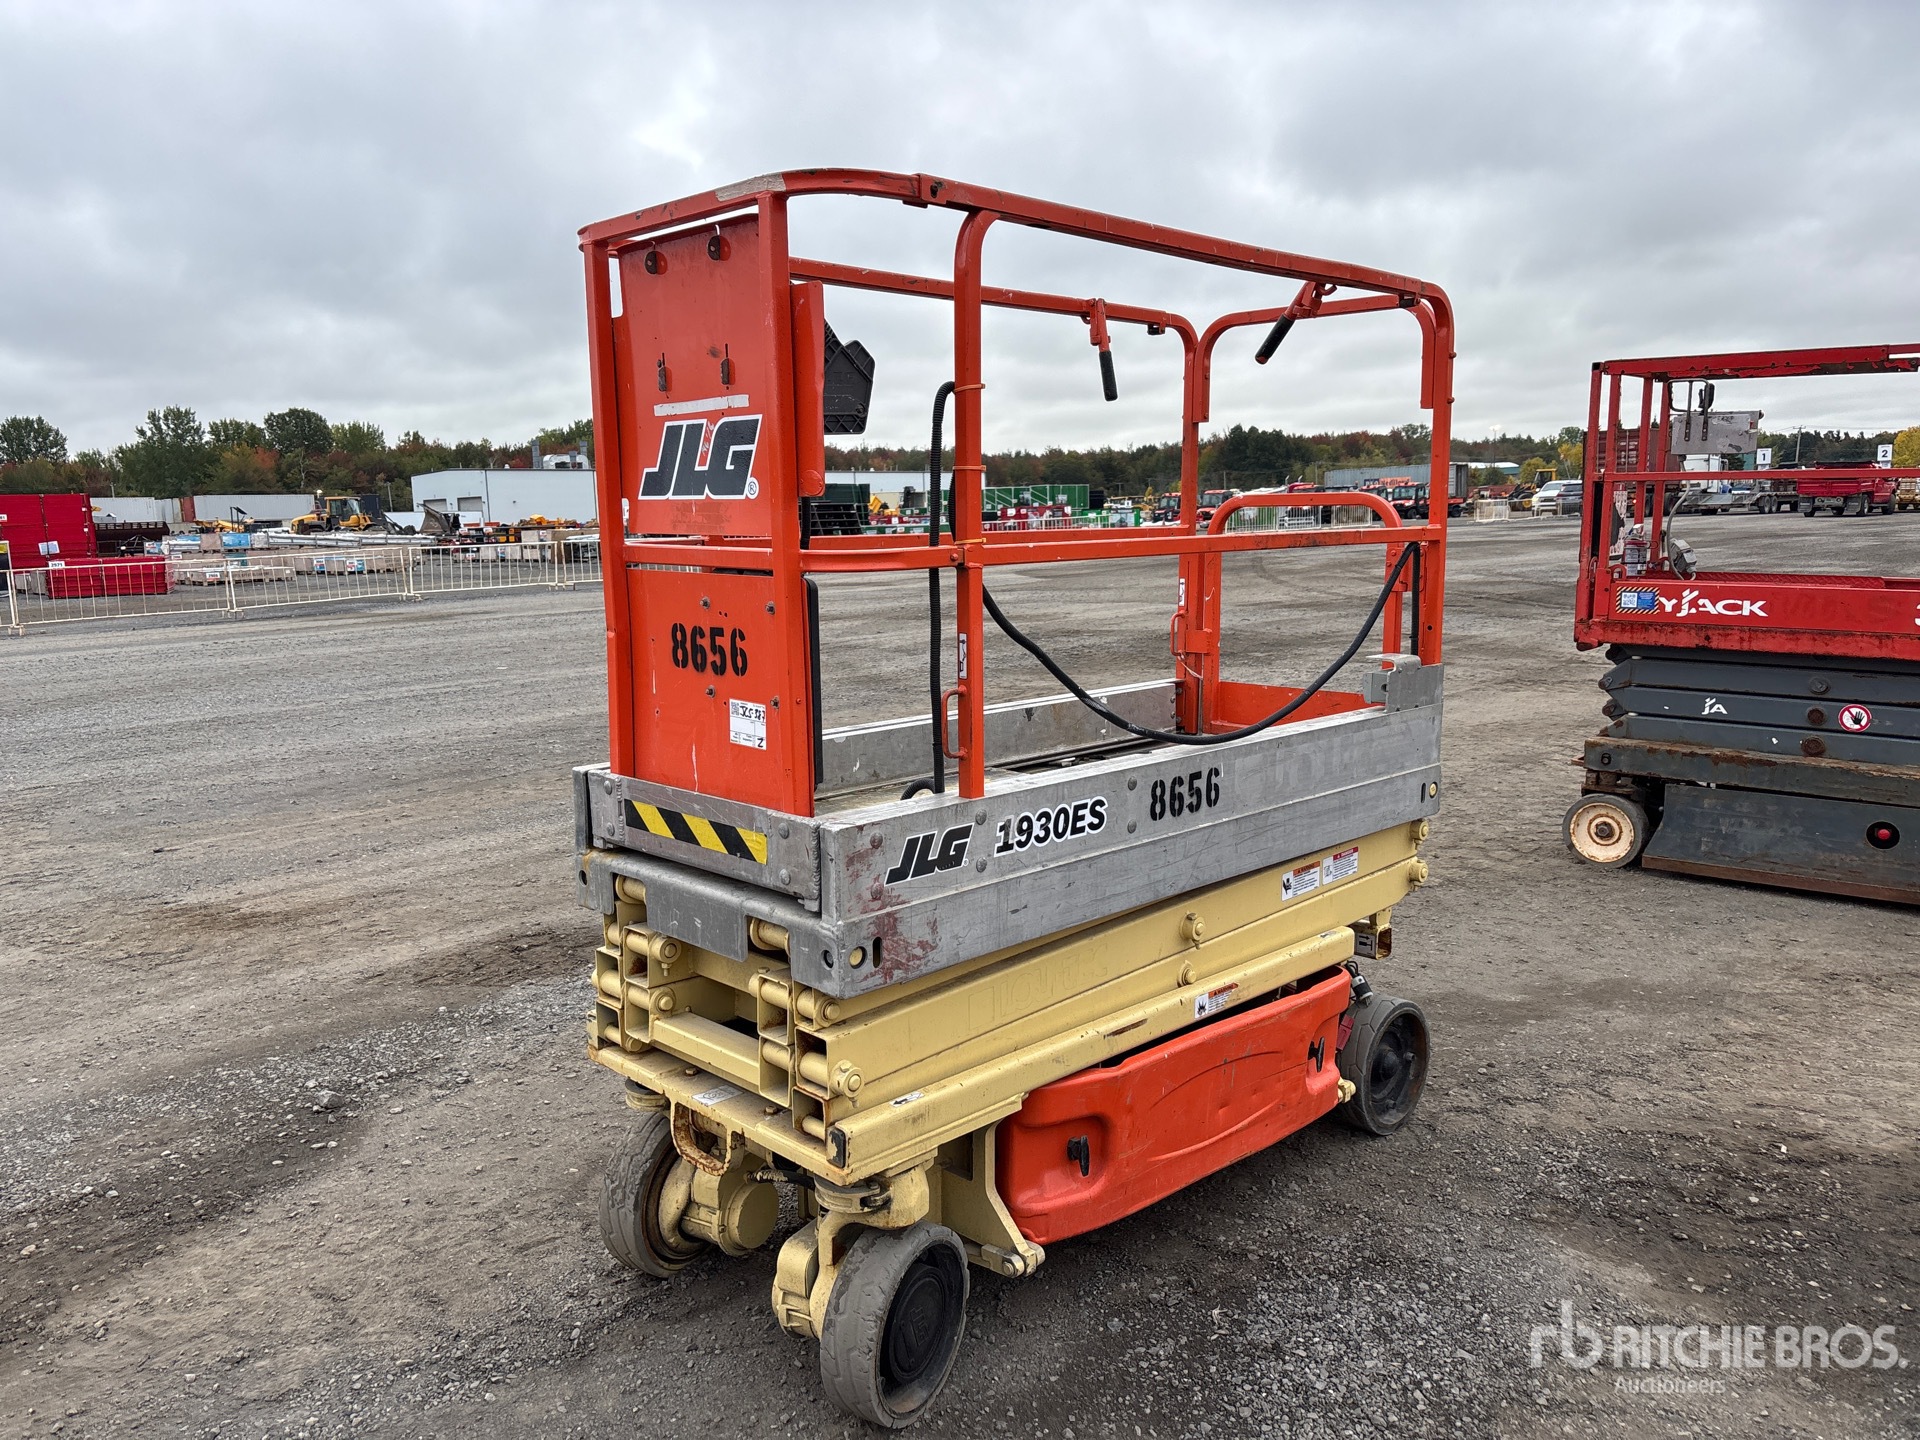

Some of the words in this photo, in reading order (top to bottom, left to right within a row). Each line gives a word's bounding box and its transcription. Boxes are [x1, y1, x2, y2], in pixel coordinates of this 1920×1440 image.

[1881, 449, 1889, 458] 2
[671, 622, 748, 677] 8656
[1149, 766, 1222, 822] 8656
[884, 822, 975, 886] JLG
[994, 797, 1108, 856] 1930ES
